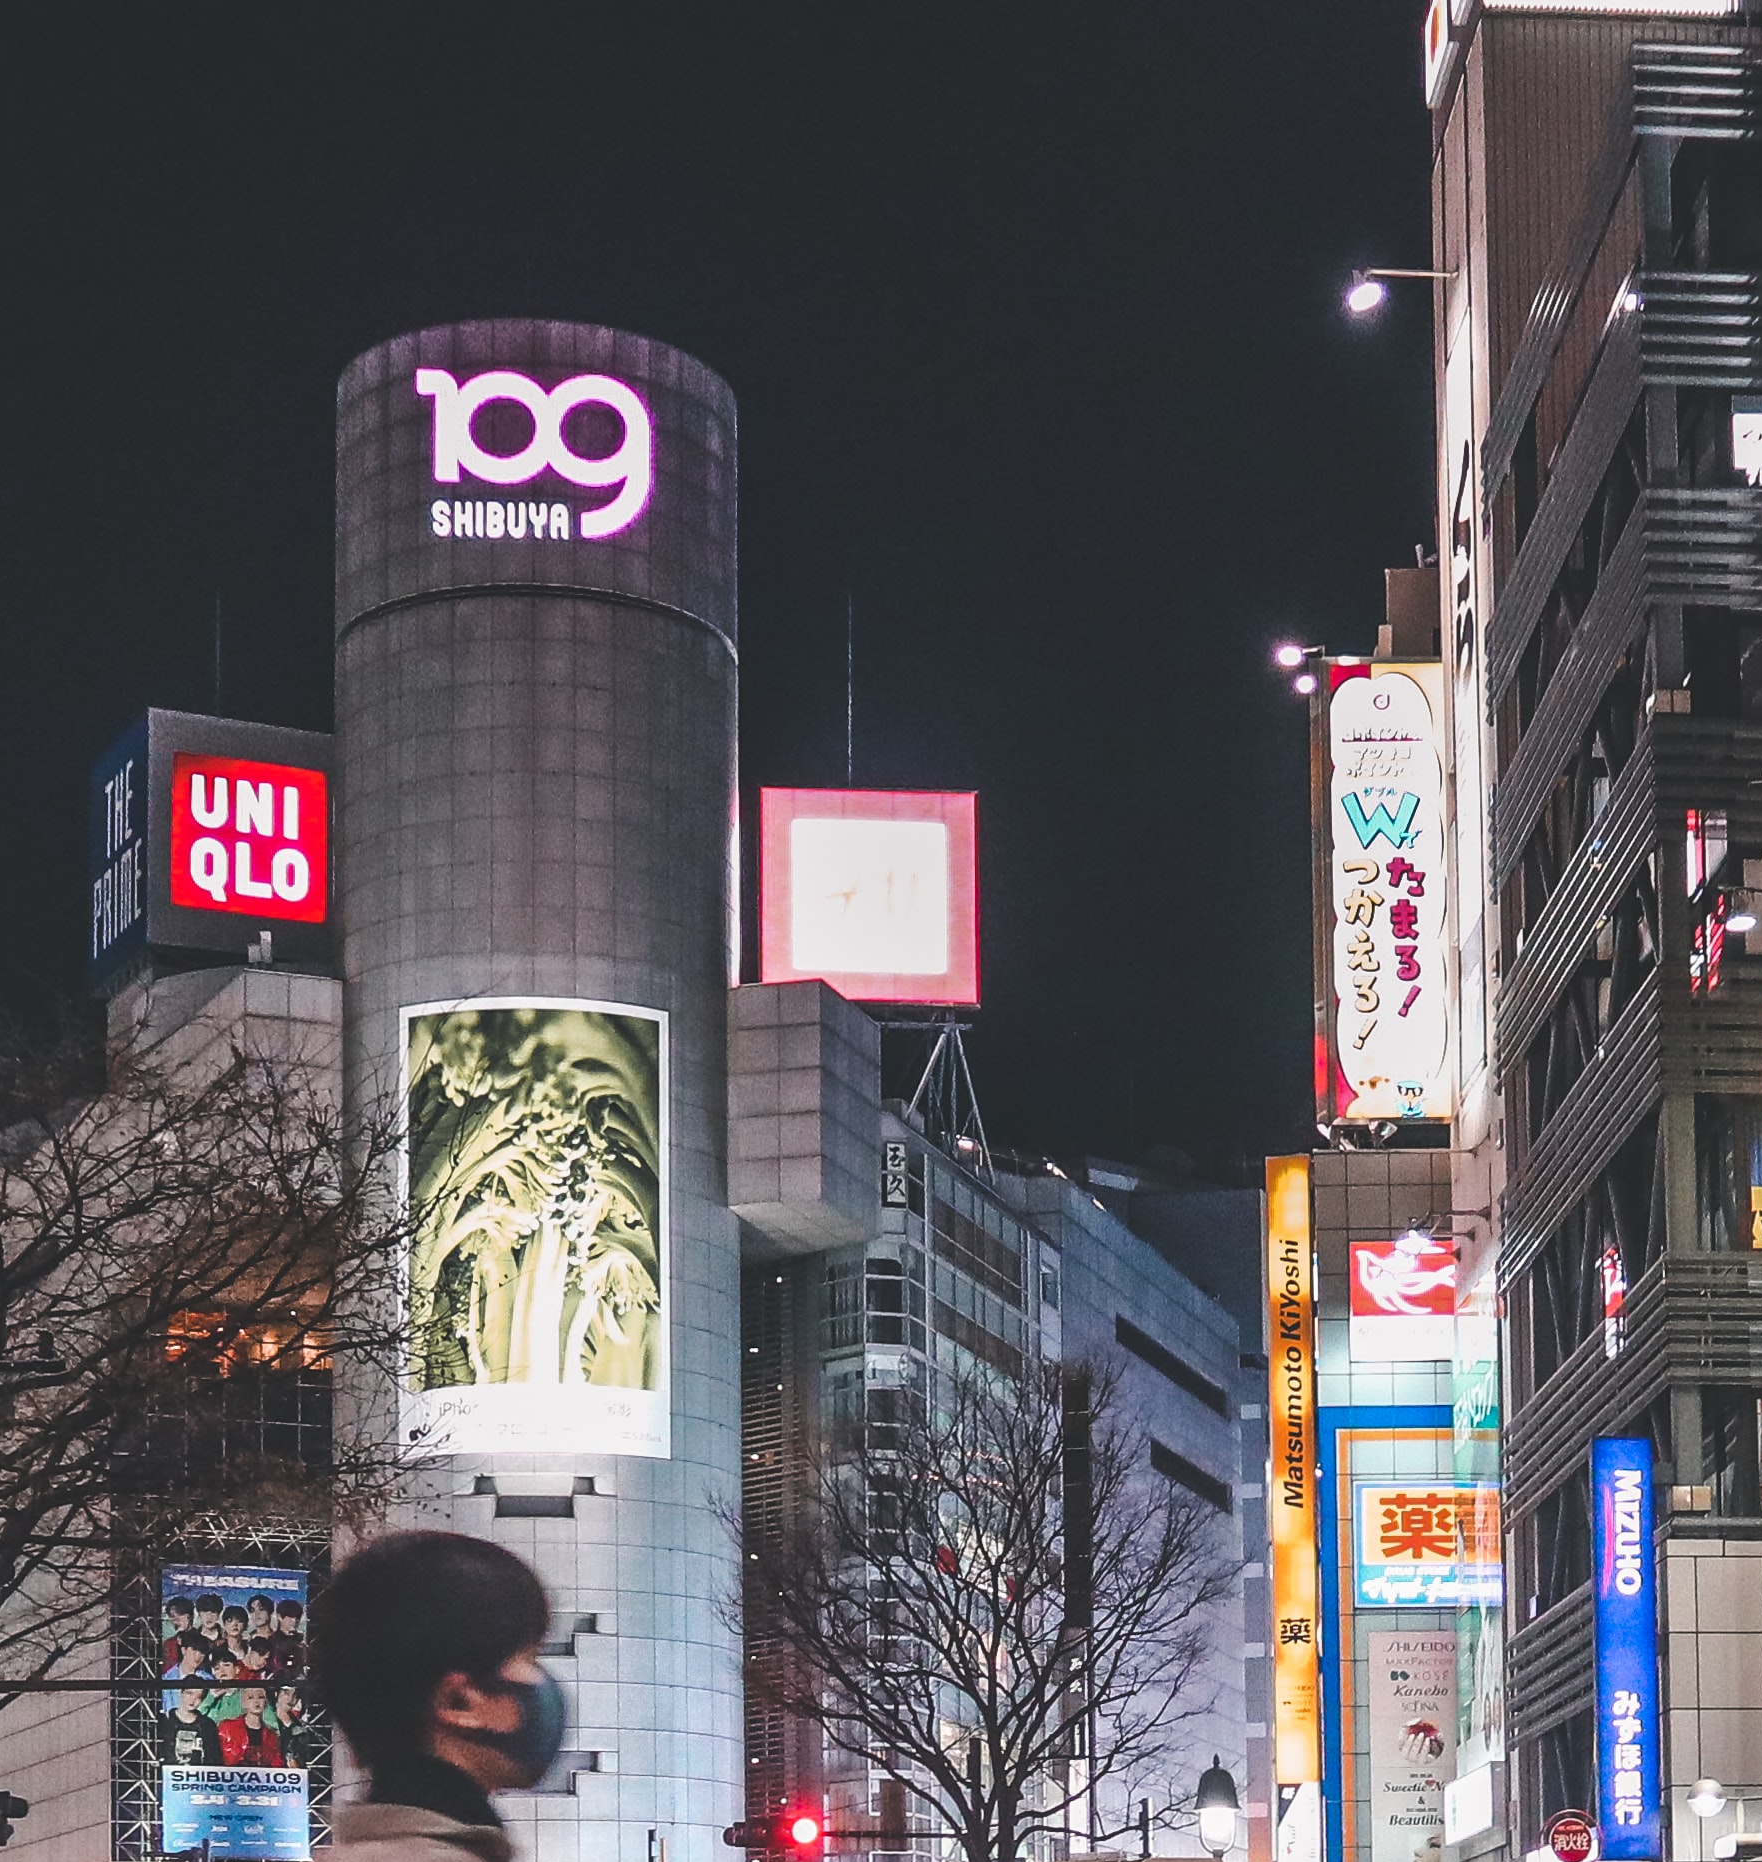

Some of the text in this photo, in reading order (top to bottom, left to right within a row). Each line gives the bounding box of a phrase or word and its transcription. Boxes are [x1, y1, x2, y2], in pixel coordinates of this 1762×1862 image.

[416, 368, 655, 538] 109
[431, 500, 571, 541] SHIBUYA
[104, 756, 135, 851] THE
[189, 773, 300, 842] UNI
[93, 834, 144, 960] PRIME
[189, 834, 311, 905] QLO
[1283, 1343, 1306, 1510] Matsumoto
[1379, 1492, 1456, 1560] 薬
[1611, 1467, 1643, 1598] MIZUHO
[1279, 1617, 1312, 1645] 薬
[1383, 1640, 1456, 1654] SHISEIDO
[1392, 1684, 1449, 1697] Kanebo
[171, 1770, 302, 1786] SHIBUYA 109
[171, 1783, 302, 1794] SPRING CAMPAIGN
[1610, 1690, 1644, 1827] みずほ銀行
[1553, 1832, 1590, 1852] 消火栓
